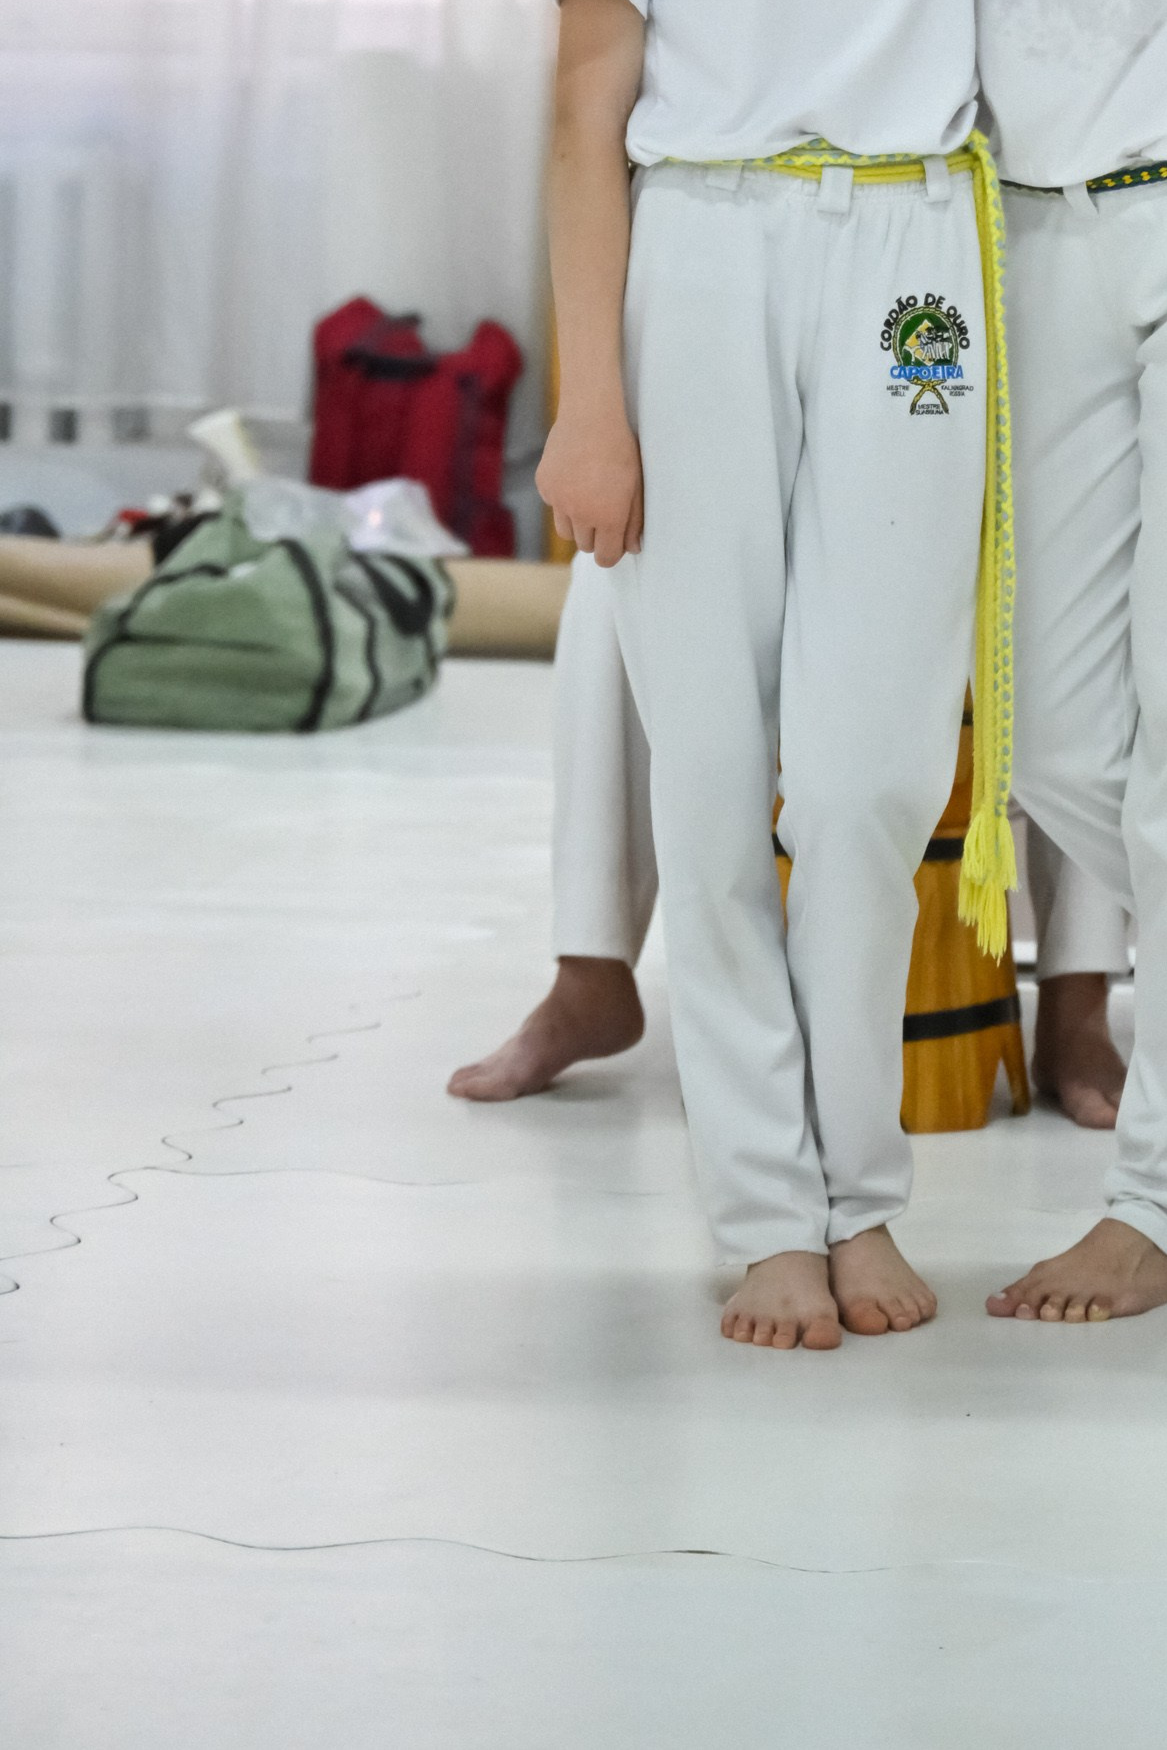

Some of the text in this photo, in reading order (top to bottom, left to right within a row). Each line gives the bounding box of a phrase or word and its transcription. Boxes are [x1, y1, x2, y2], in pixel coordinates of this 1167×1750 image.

[880, 293, 970, 351] CORDÃO DE OURO
[890, 365, 964, 380] CAPOEIRA
